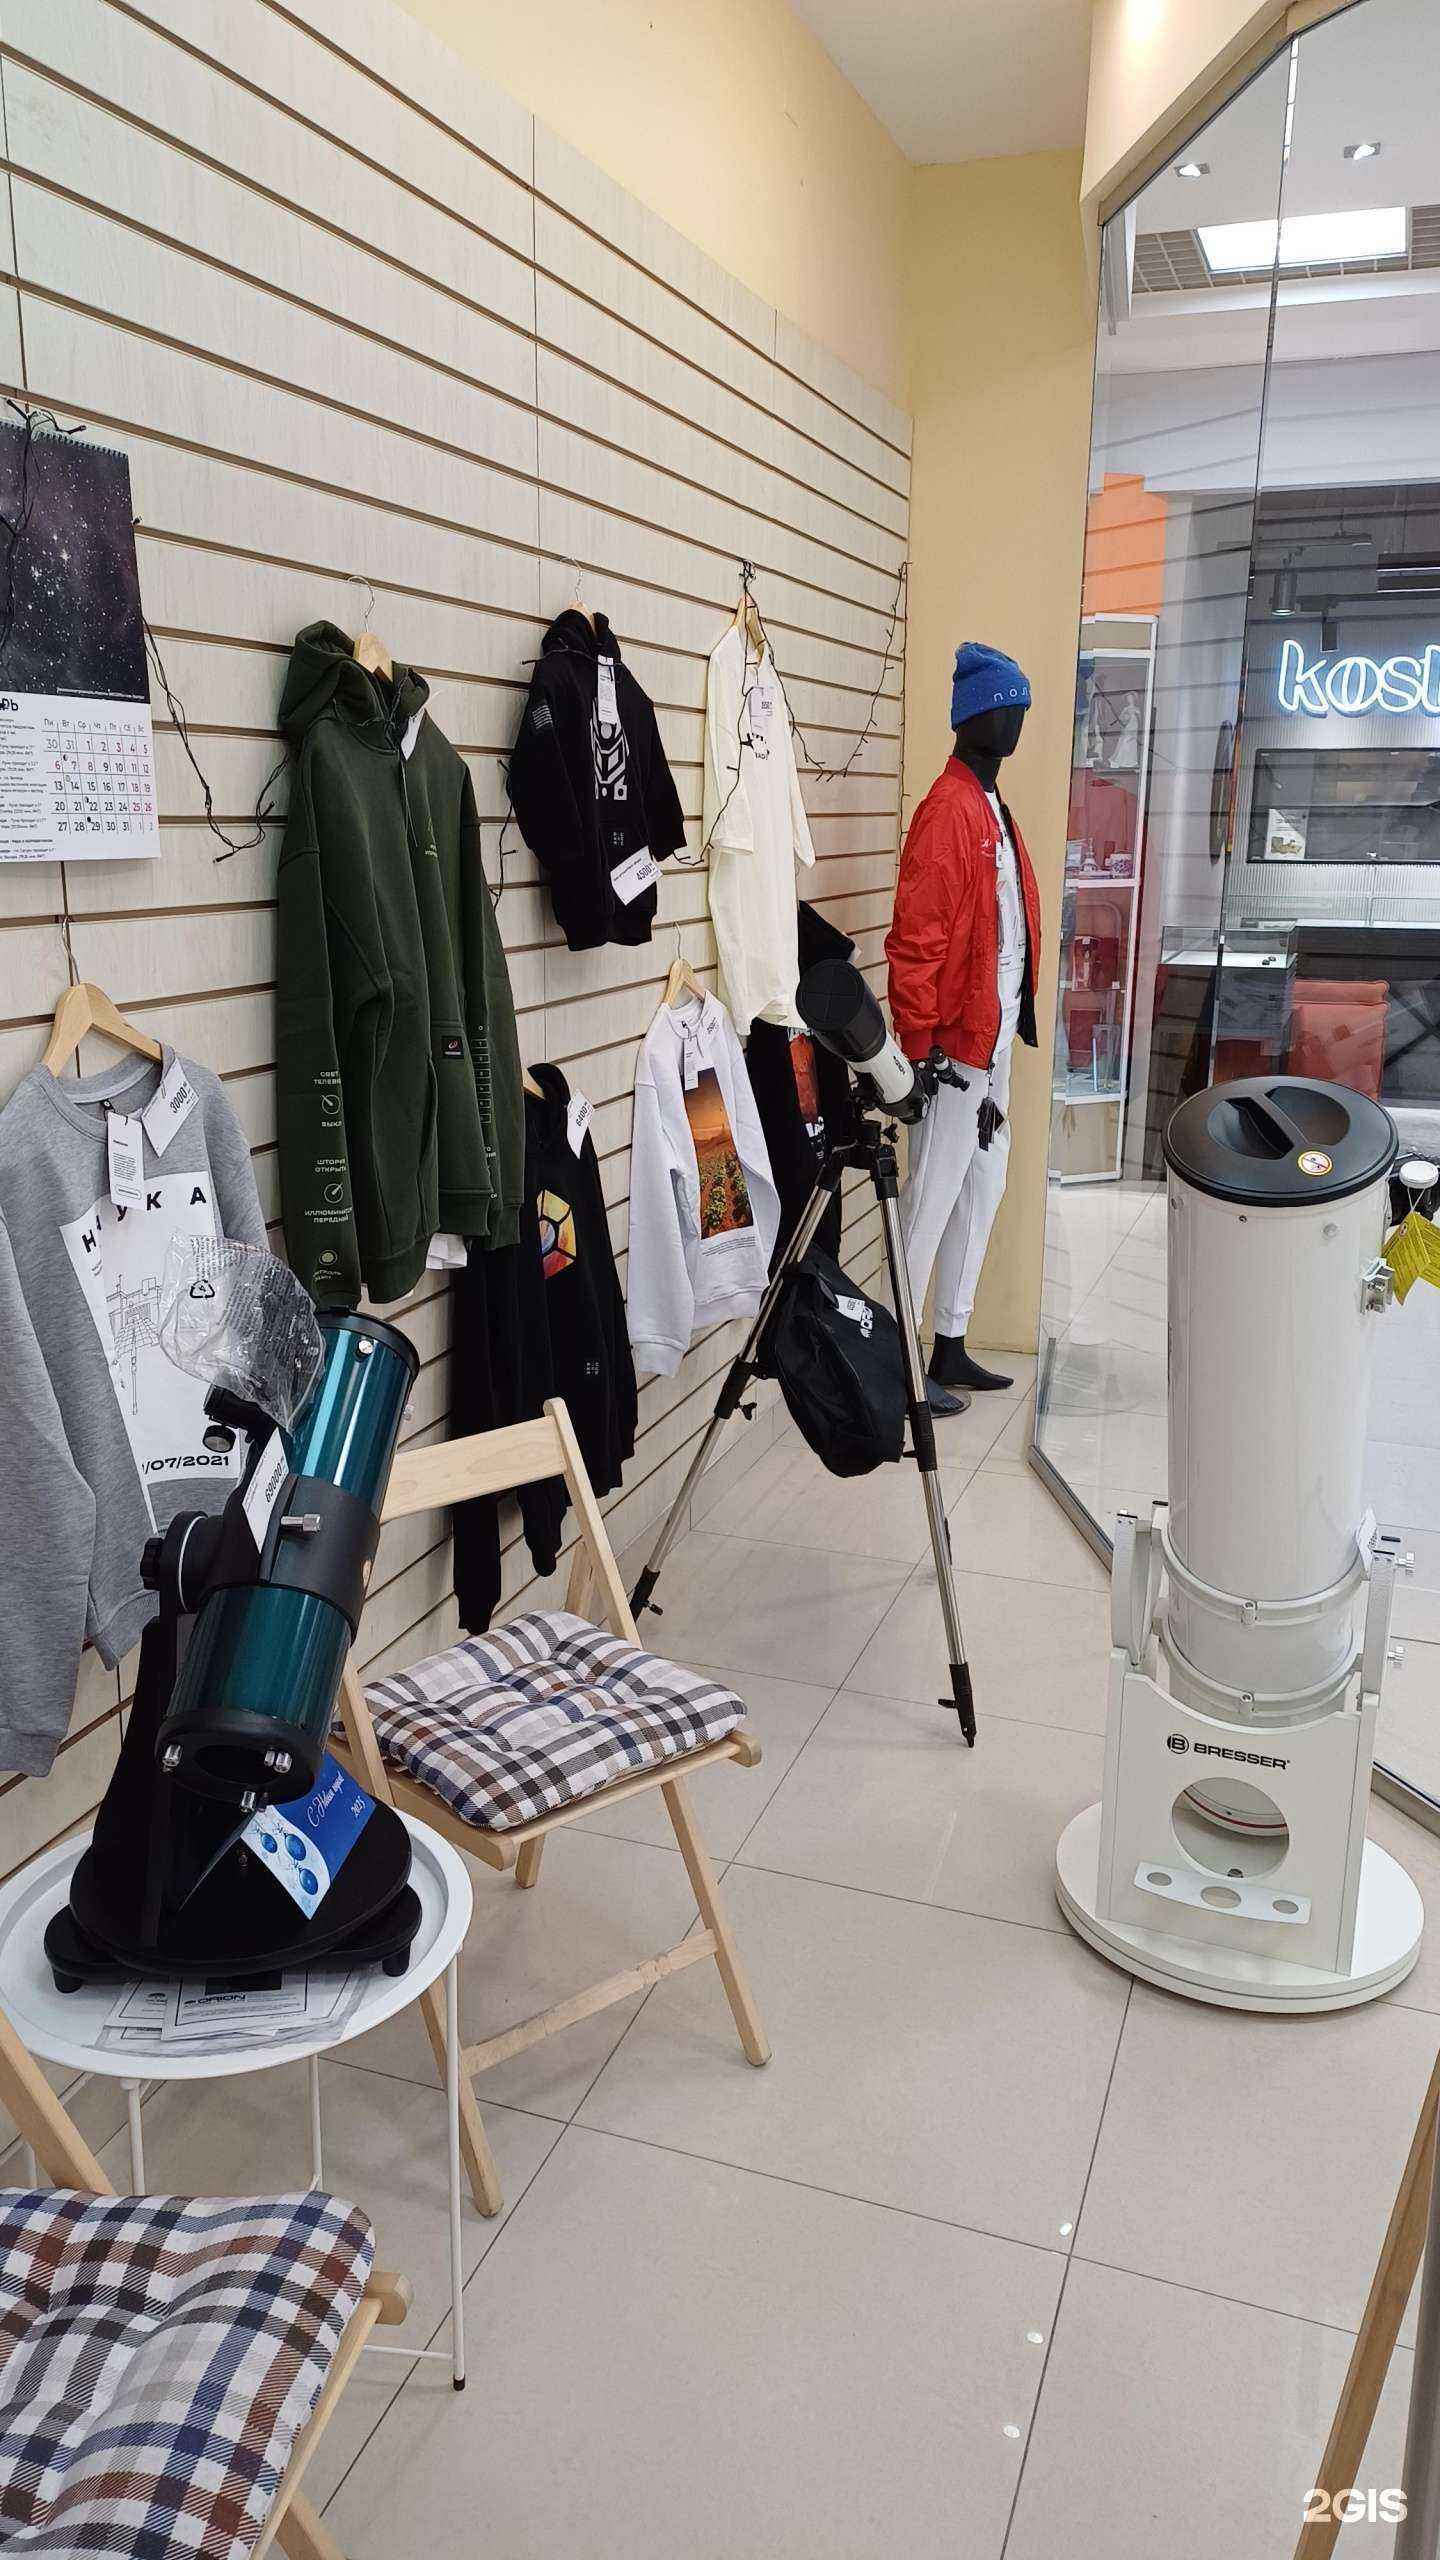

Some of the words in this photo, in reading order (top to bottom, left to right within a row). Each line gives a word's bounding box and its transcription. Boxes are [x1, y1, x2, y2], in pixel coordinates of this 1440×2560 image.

[46, 738, 58, 749] 30
[65, 739, 75, 750] 31
[86, 740, 91, 751] 1
[100, 741, 107, 752] 2
[115, 742, 122, 753] 3
[130, 743, 135, 752] 4
[143, 744, 148, 754] 5
[55, 760, 61, 770] 6
[71, 761, 77, 770] 7
[87, 761, 94, 771] 8
[103, 762, 109, 772] 9
[115, 763, 124, 773] 10
[131, 763, 137, 773] 11
[142, 763, 149, 774] 12
[54, 780, 64, 791] 13
[70, 781, 80, 792] 14
[87, 781, 96, 792] 15
[102, 782, 112, 792] 16
[117, 782, 126, 792] 17
[131, 783, 139, 793] 18
[144, 783, 151, 793] 19
[55, 801, 66, 811] 20
[74, 802, 82, 811] 21
[89, 801, 98, 811] 22
[104, 802, 114, 812] 23
[118, 802, 128, 812] 24
[132, 802, 141, 812] 25
[144, 803, 153, 812] 26
[57, 822, 67, 832] 27
[74, 822, 86, 832] 28
[91, 821, 100, 831] 29
[106, 821, 116, 831] 30
[122, 821, 130, 831] 31
[636, 865, 653, 881] 4500
[169, 1086, 189, 1114] 3000
[576, 1105, 588, 1127] 6400
[265, 1462, 283, 1503] 69000
[1194, 1743, 1288, 1770] BRESSER
